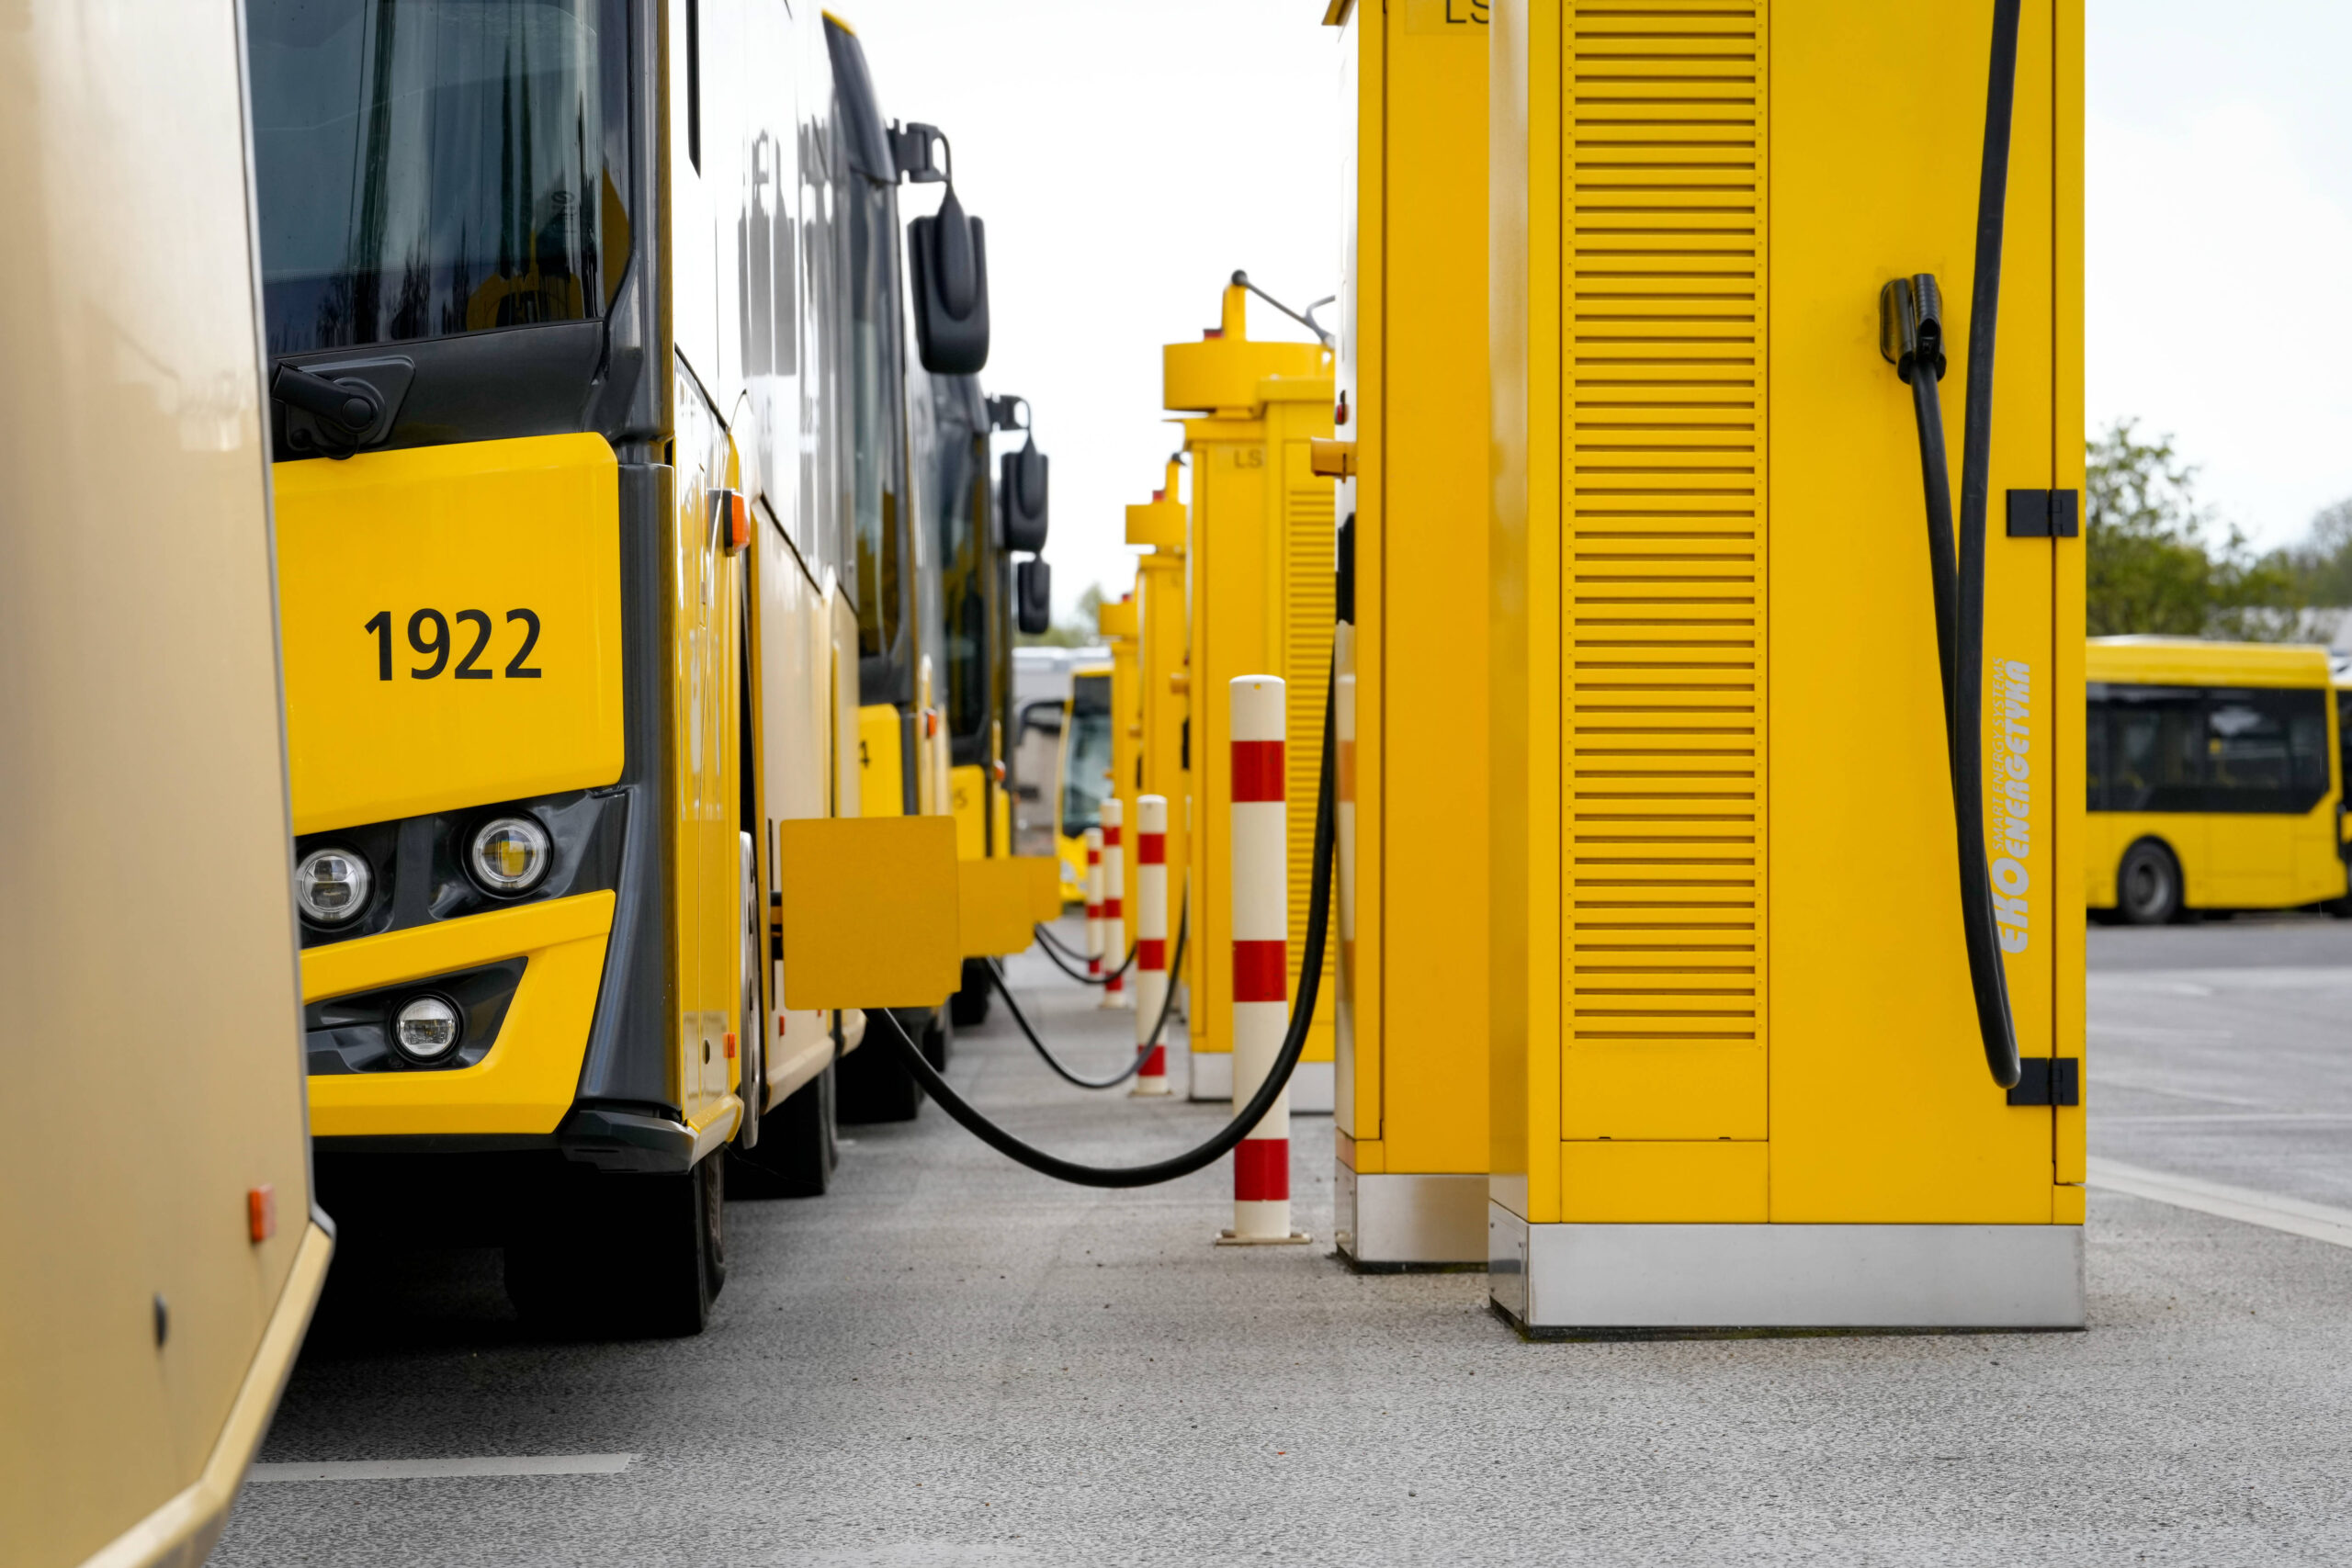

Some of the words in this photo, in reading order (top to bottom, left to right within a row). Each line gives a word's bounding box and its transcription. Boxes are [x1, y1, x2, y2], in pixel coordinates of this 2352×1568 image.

[1234, 448, 1262, 468] LS
[365, 608, 541, 681] 1922
[1992, 656, 2005, 728] SYSTEMS
[1992, 729, 2005, 794] ENERGY
[1992, 795, 2005, 852] SMART
